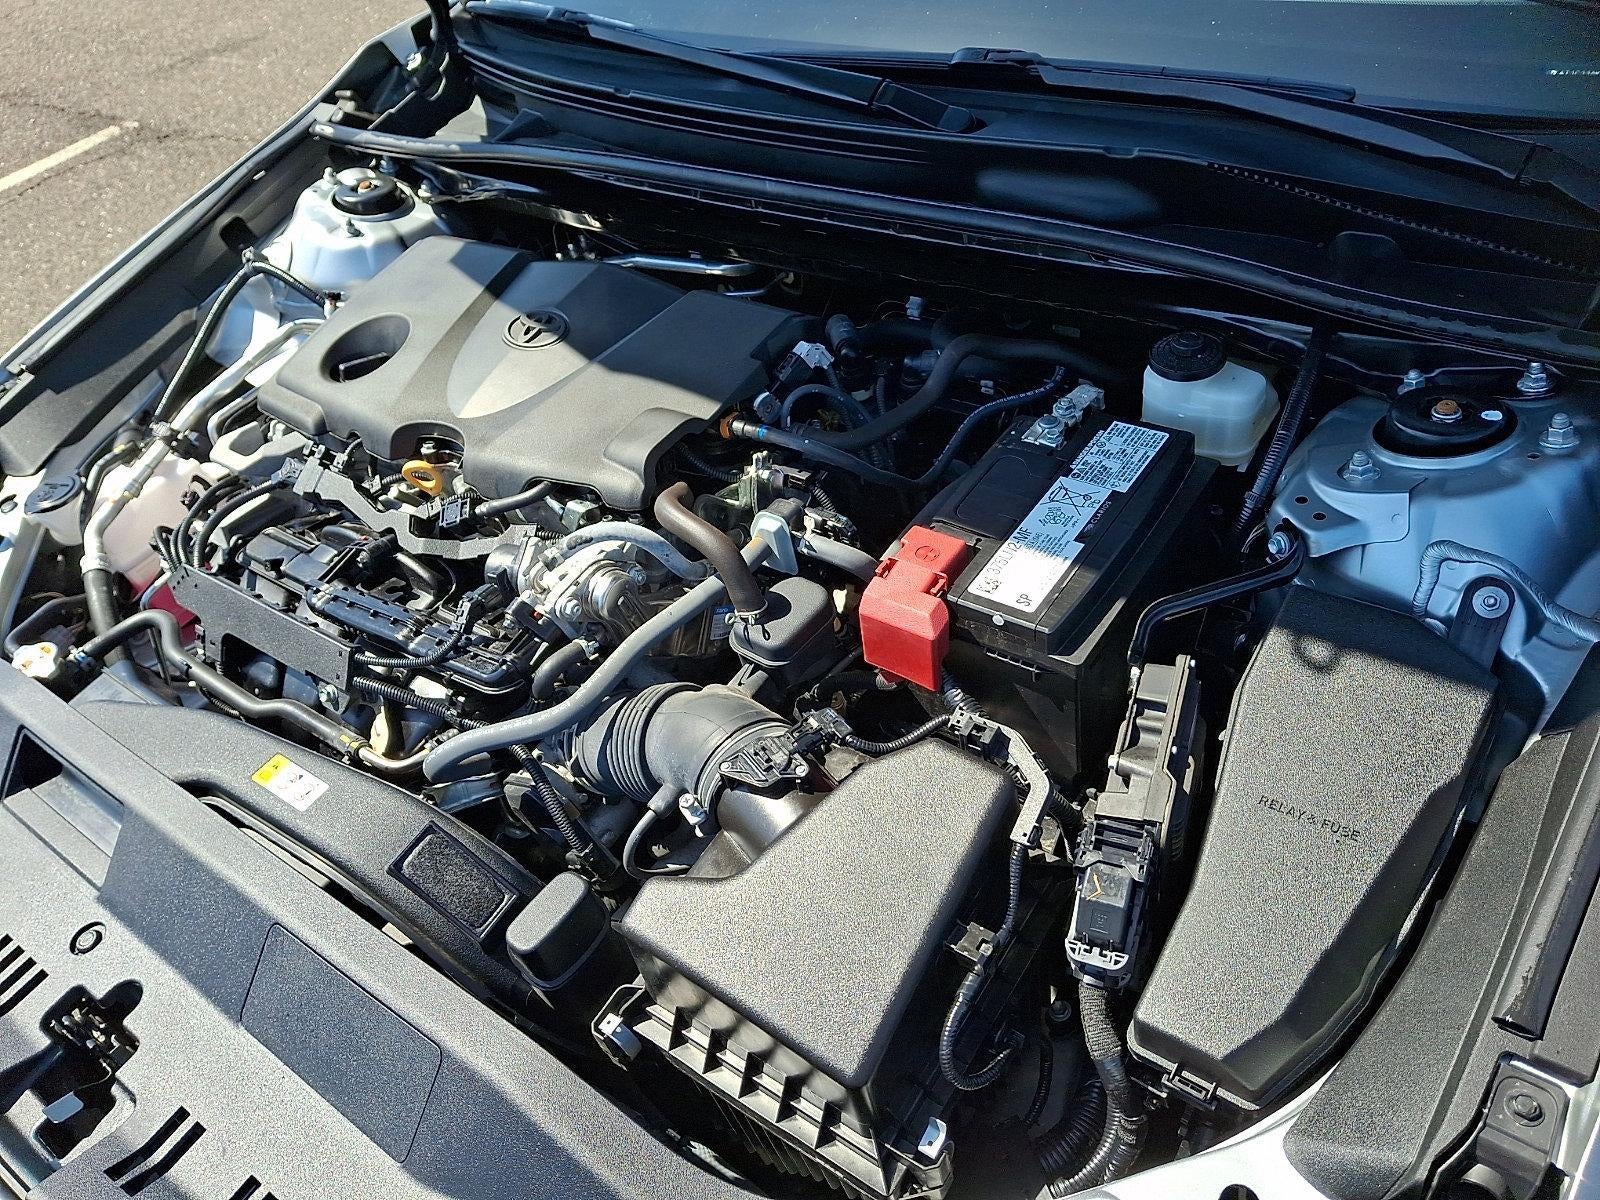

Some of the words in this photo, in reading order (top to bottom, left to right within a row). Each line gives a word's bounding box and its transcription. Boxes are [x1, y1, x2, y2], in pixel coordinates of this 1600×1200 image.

[1087, 499, 1101, 509] Pb
[1091, 501, 1112, 524] CLARIOS
[1016, 593, 1032, 607] SP
[1257, 795, 1305, 820] RELAY
[1307, 813, 1318, 825] &
[1320, 818, 1361, 842] FUSE
